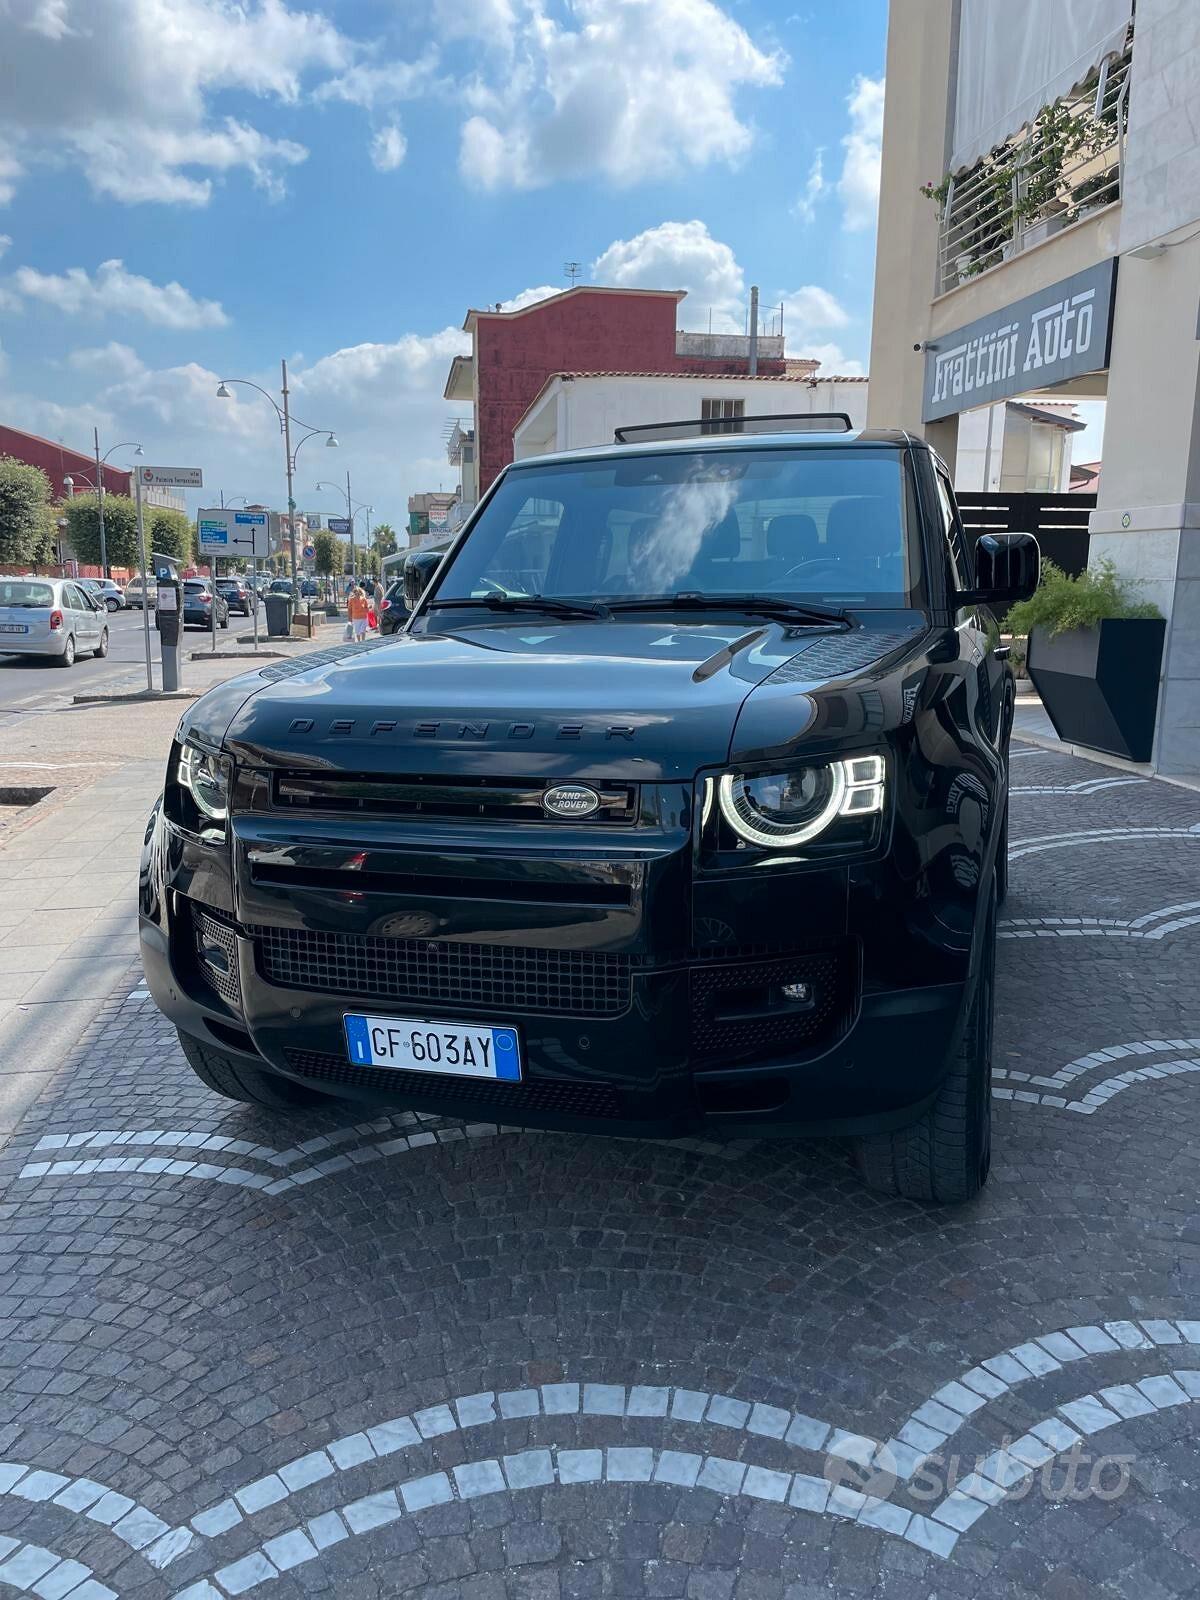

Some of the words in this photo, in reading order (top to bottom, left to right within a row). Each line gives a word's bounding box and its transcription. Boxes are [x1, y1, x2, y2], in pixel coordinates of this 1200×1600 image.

[931, 322, 1020, 404] Frattini
[1022, 288, 1096, 372] Auto
[160, 567, 168, 577] P
[287, 717, 637, 742] DEFENDER
